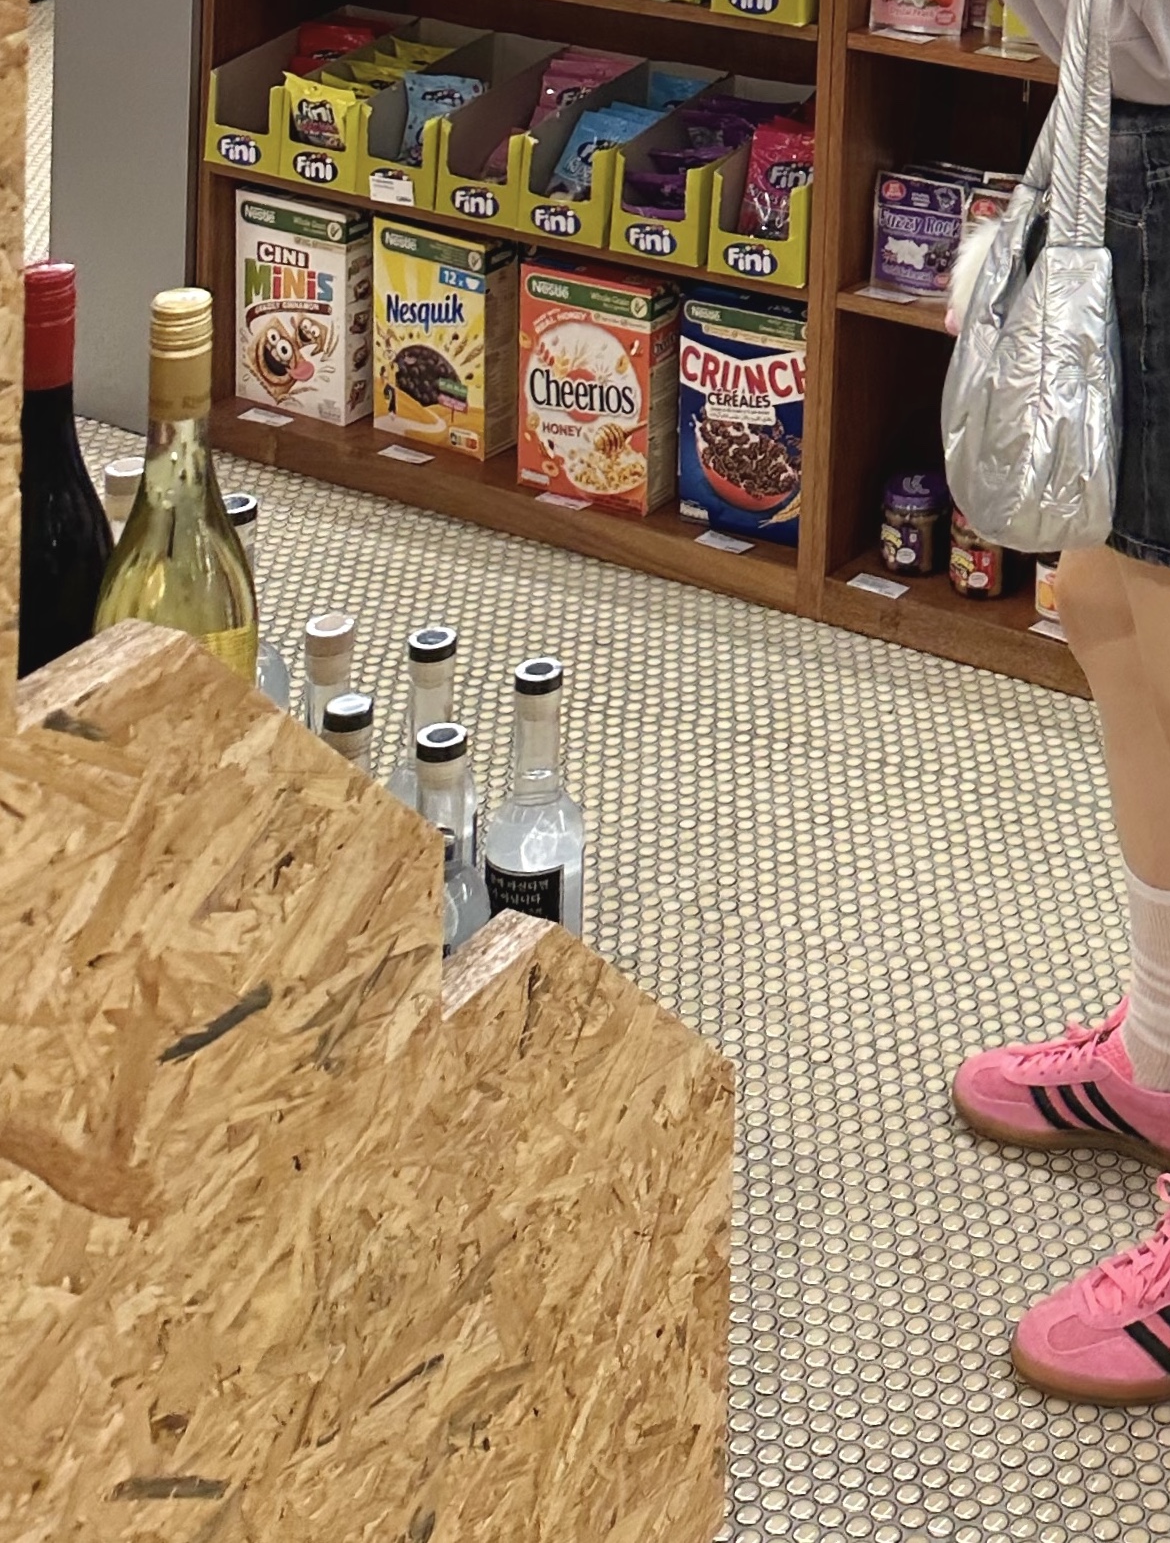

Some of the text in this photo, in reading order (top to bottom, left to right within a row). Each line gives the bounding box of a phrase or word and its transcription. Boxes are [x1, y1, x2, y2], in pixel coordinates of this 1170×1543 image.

[302, 100, 333, 123] Fini
[219, 138, 257, 164] Fini
[296, 155, 333, 181] Fini
[454, 190, 494, 216] Fini
[533, 208, 577, 235] Fini
[628, 227, 672, 255] Fini
[258, 243, 306, 267] CINI
[727, 246, 772, 275] Fini
[443, 269, 457, 286] 12
[386, 294, 465, 333] Nesquik
[530, 368, 635, 415] Cheerios
[542, 422, 582, 438] HONEY
